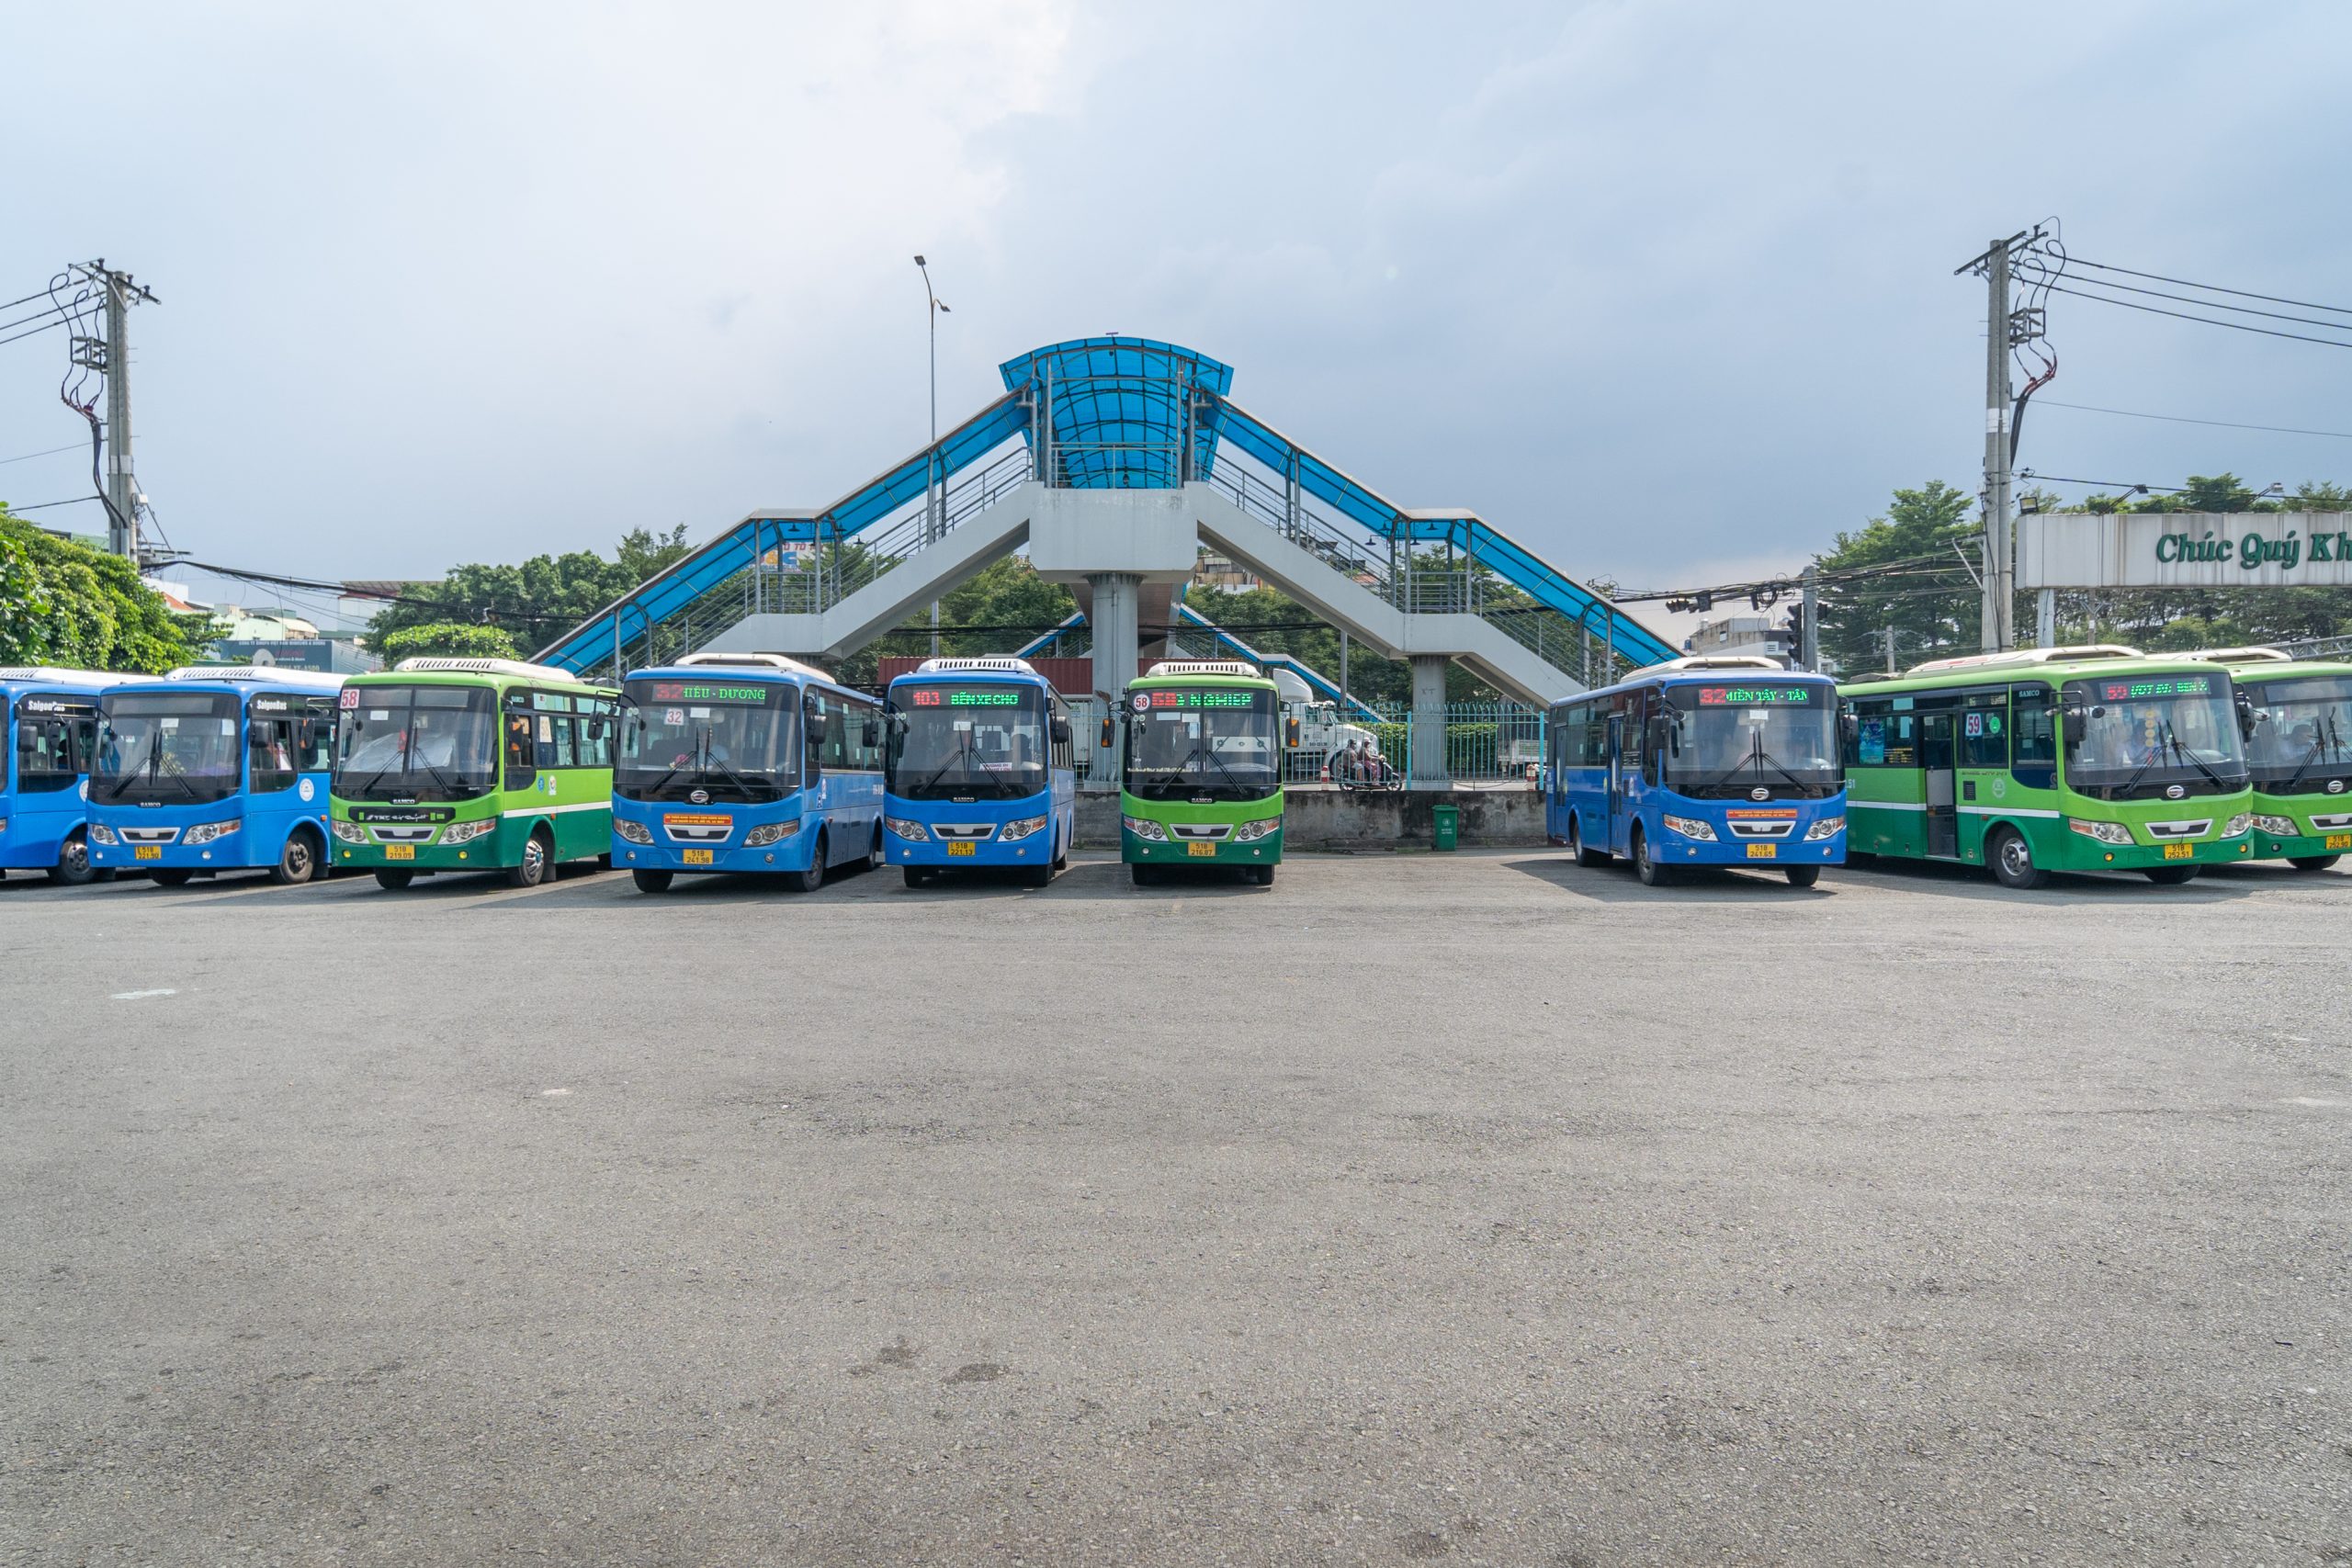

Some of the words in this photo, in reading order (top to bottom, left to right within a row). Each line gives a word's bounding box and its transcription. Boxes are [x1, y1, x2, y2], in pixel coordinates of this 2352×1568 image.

[2156, 531, 2233, 563] Chúc
[2240, 530, 2301, 570] Quý
[342, 691, 357, 707] 58
[913, 691, 940, 705] 103
[1136, 697, 1148, 707] 58
[1701, 689, 1726, 704] 32
[667, 711, 682, 724] 32
[1968, 716, 1980, 734] 59
